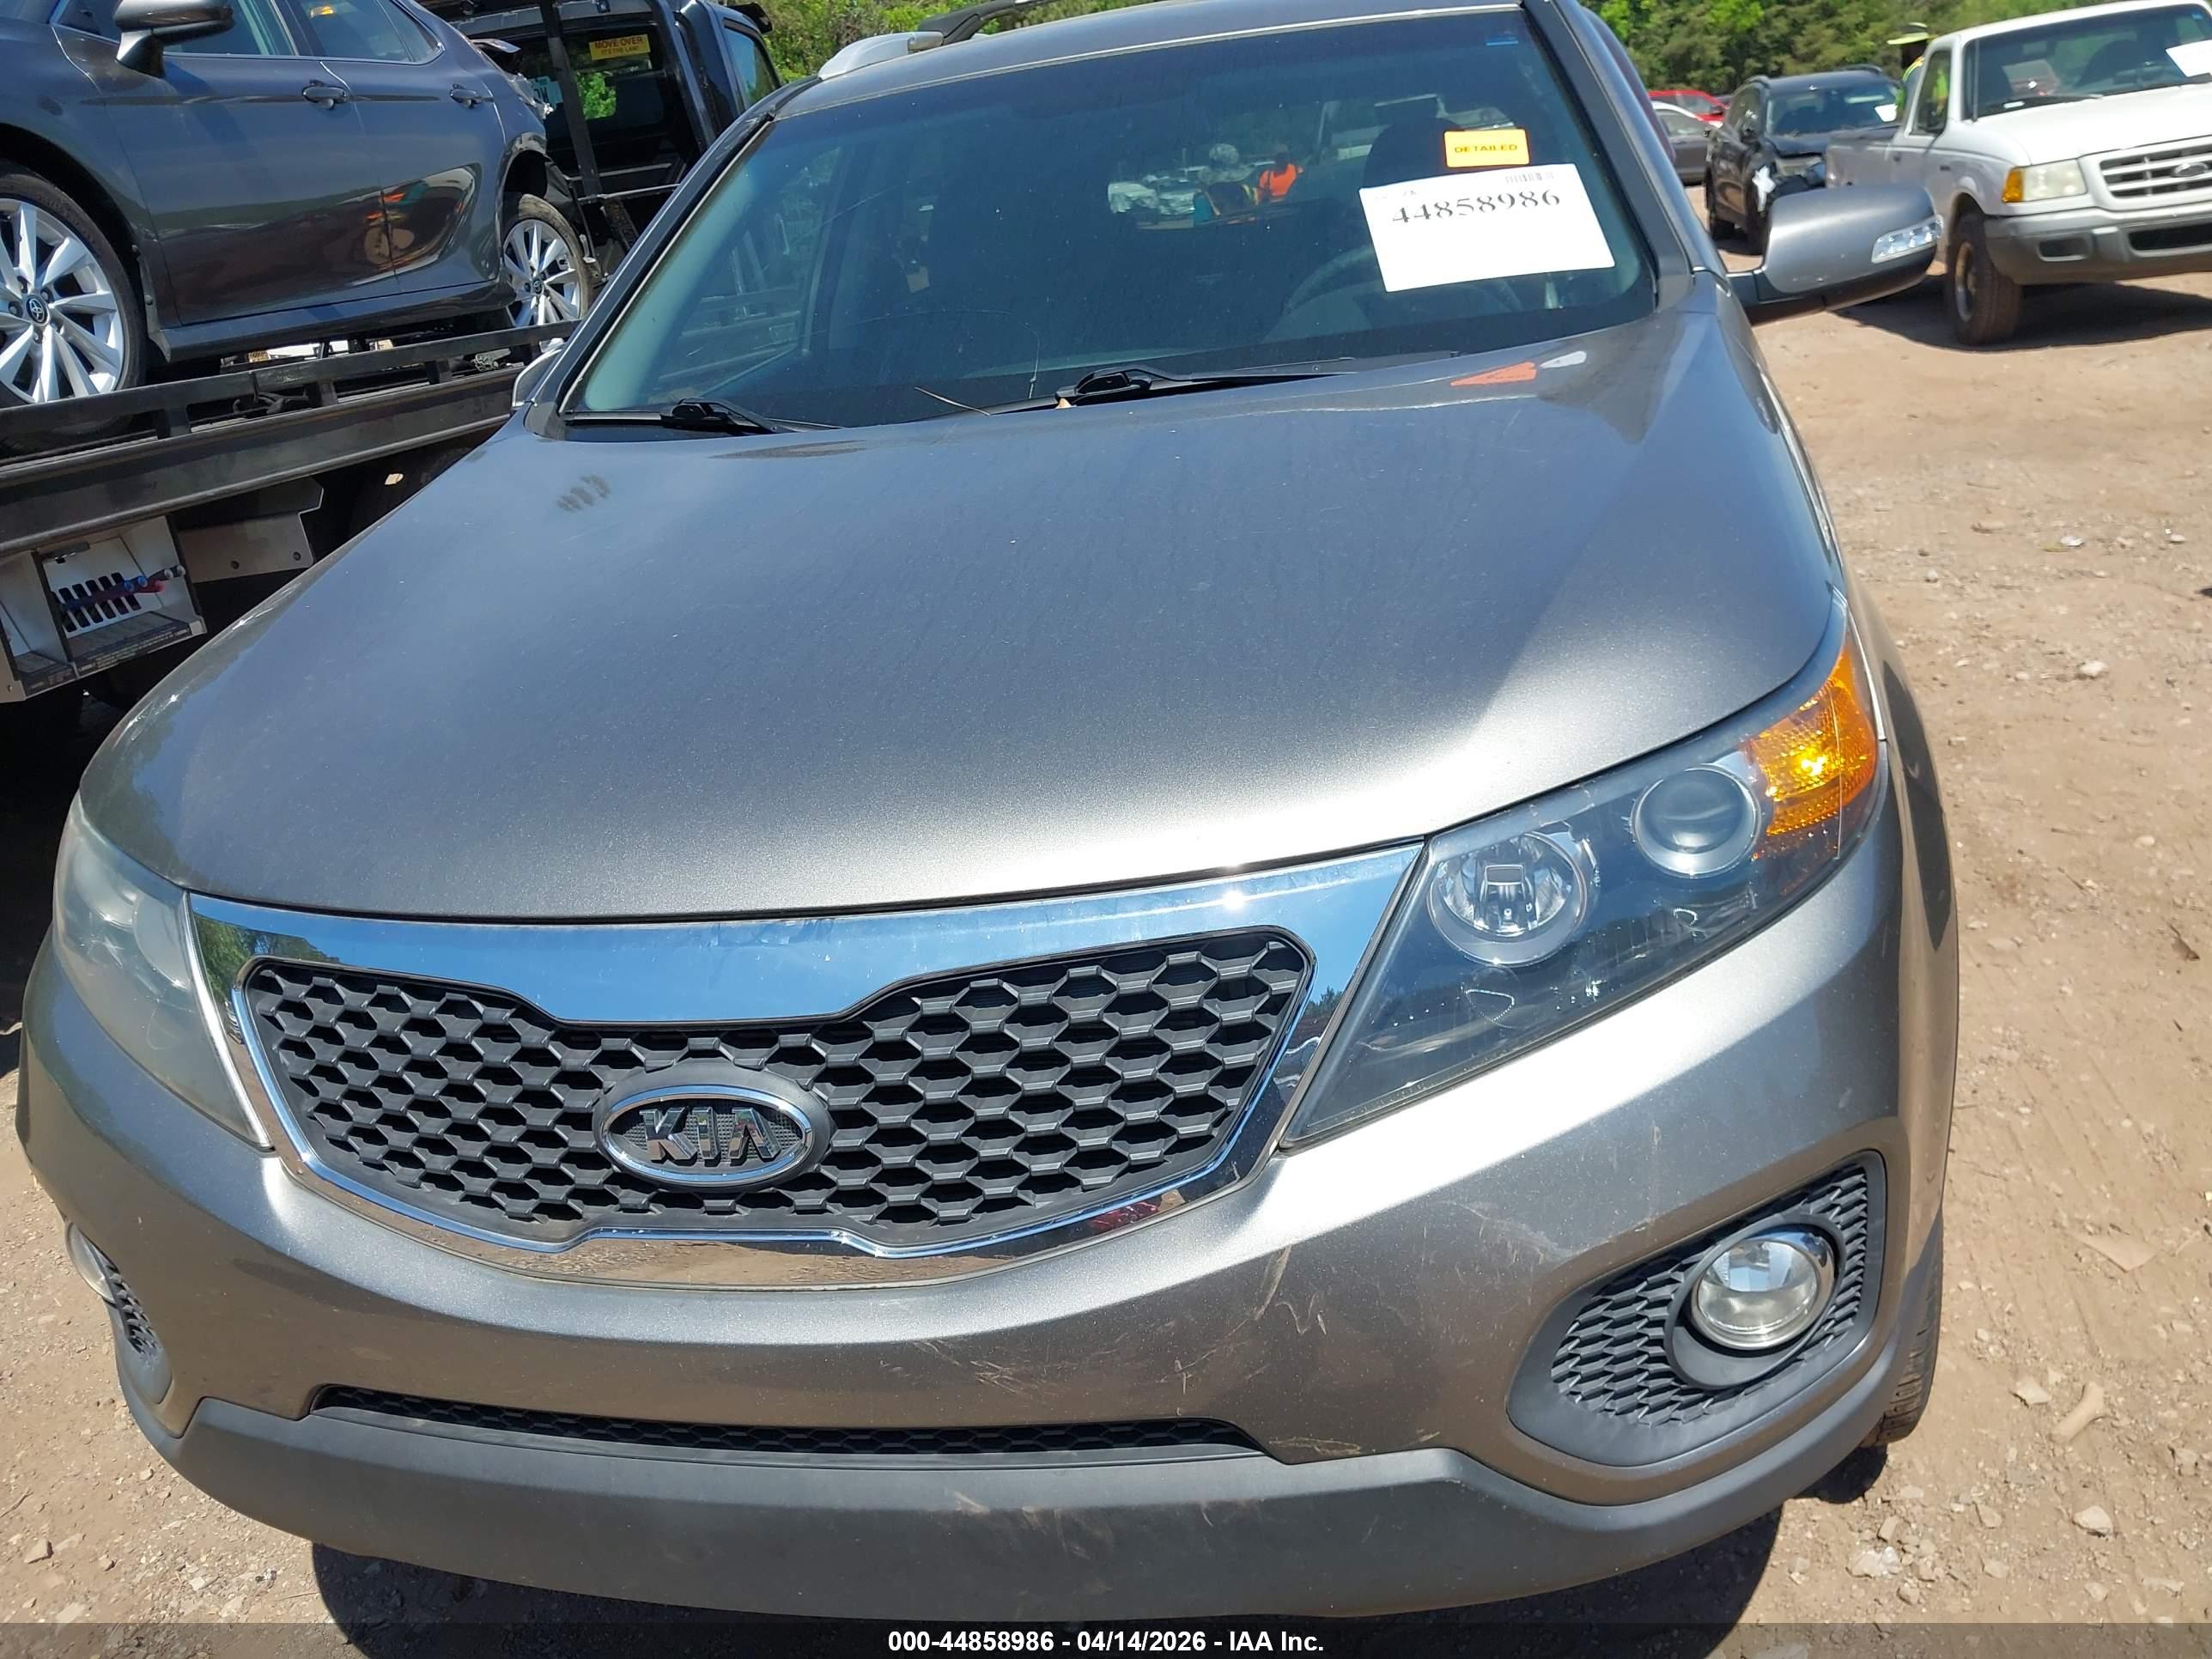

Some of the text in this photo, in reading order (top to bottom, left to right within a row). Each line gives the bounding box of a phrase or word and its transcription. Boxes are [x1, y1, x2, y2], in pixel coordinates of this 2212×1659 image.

[621, 36, 643, 46] OVER
[1454, 144, 1518, 153] DETAILED
[1392, 190, 1561, 223] 44858986
[640, 1106, 781, 1160] KIA
